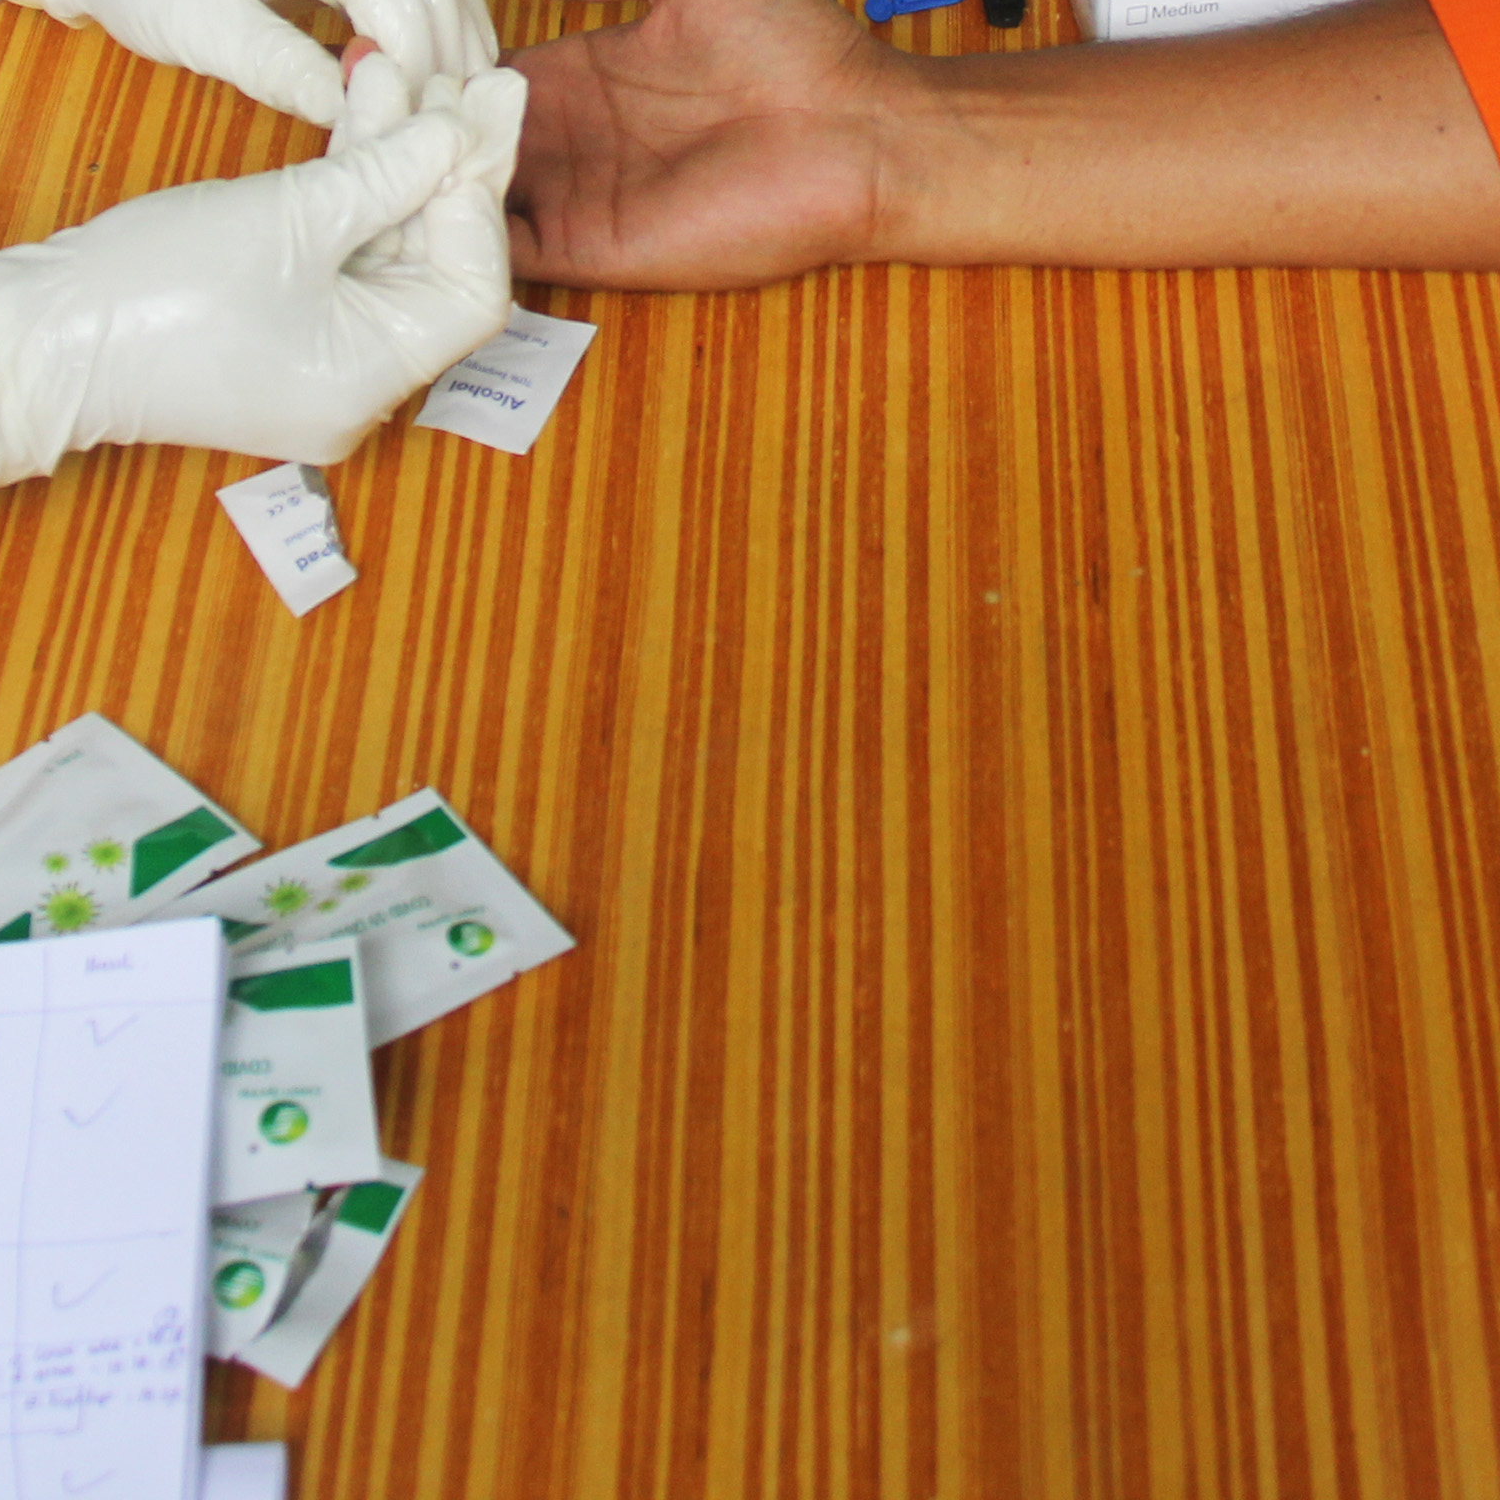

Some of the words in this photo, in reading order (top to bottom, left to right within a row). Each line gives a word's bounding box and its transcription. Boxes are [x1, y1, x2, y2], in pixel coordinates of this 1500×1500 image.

[1152, 1, 1219, 19] Medium
[448, 378, 526, 411] Alcohol
[295, 540, 341, 572] Pad
